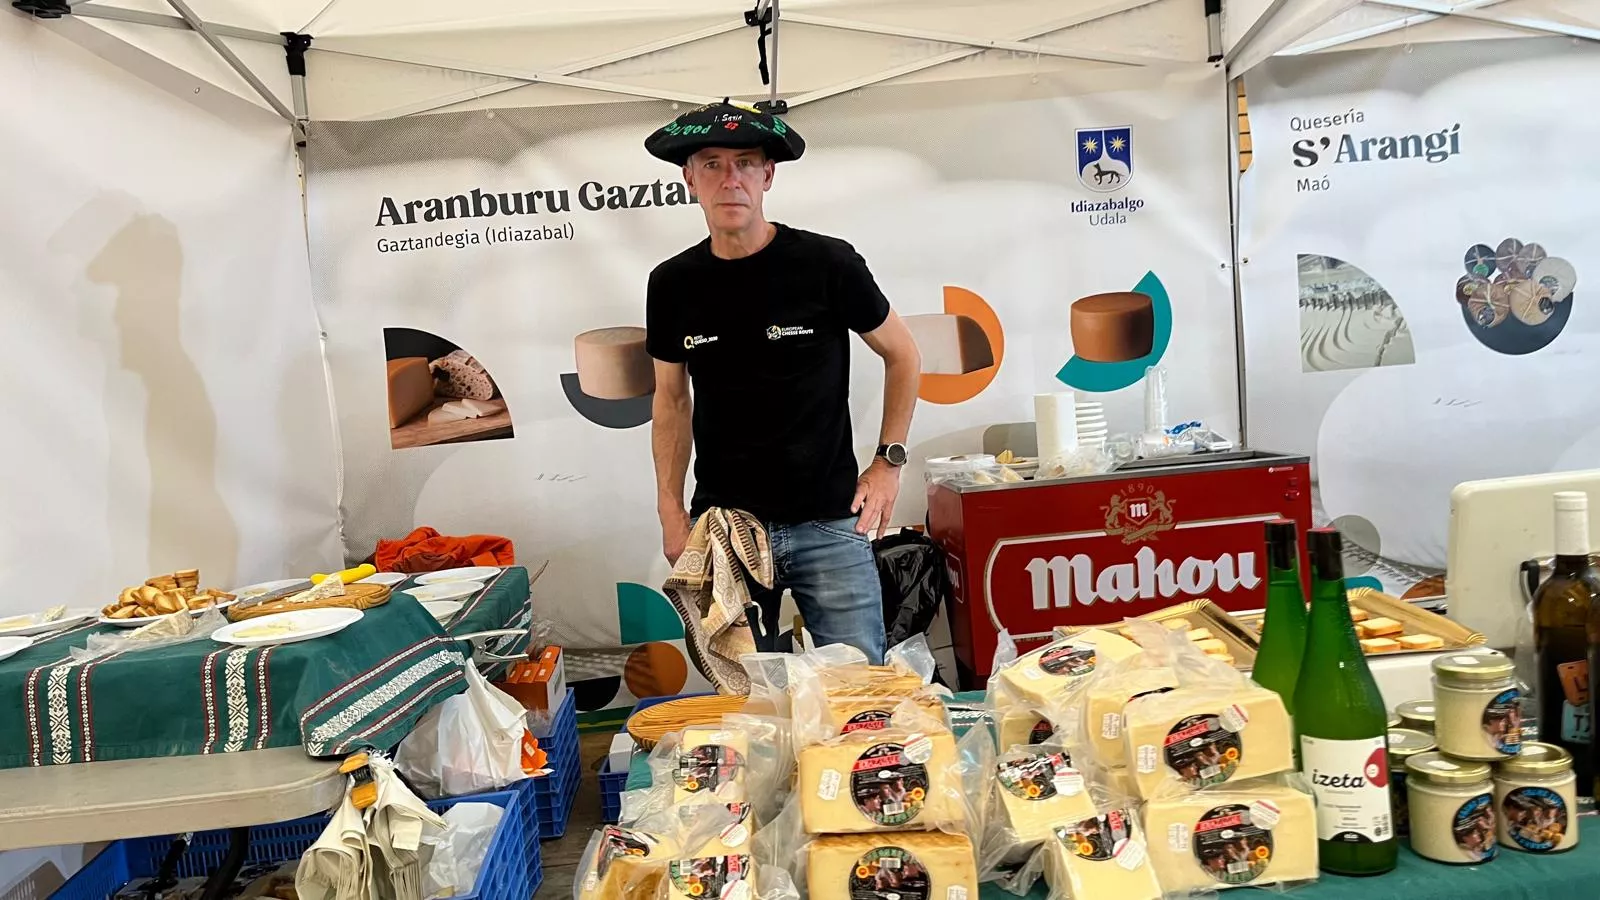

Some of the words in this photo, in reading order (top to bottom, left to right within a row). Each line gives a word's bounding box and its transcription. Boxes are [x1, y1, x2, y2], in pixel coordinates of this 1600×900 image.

[1290, 108, 1365, 132] Quesería
[1297, 175, 1330, 192] Maó
[375, 187, 571, 227] Aranburu
[578, 178, 700, 211] Gazta
[1071, 196, 1144, 212] Idiazabalgo
[1089, 211, 1127, 226] Udala
[377, 229, 480, 253] Gaztandegia
[485, 221, 575, 245] (Idiazabal)
[1120, 482, 1155, 497] 1890
[1024, 545, 1263, 610] Mahou
[1312, 768, 1367, 789] izeta
